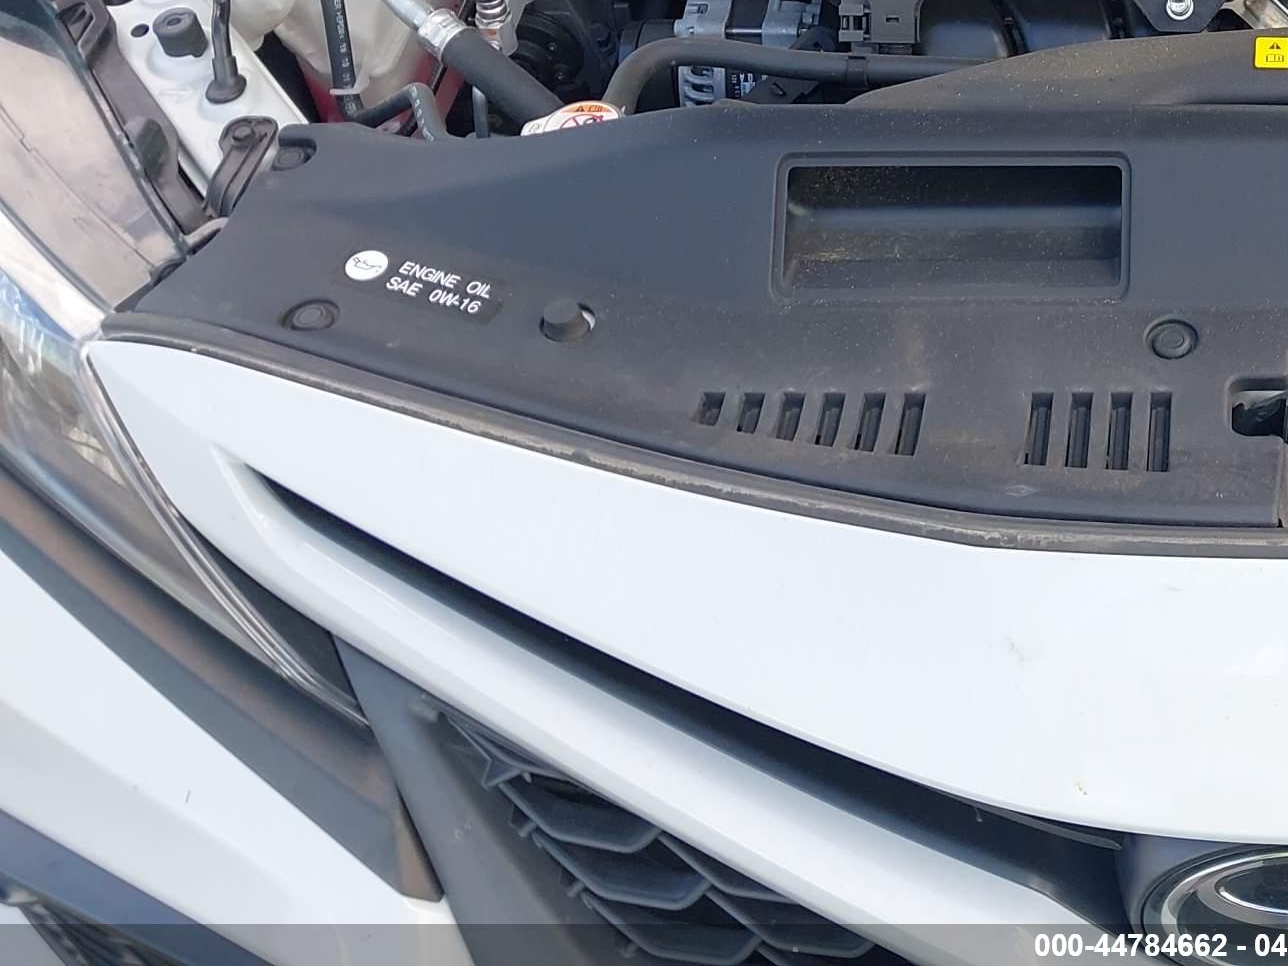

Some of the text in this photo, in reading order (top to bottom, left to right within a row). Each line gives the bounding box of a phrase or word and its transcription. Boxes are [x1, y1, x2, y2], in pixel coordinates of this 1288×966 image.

[386, 276, 481, 314] SAE 0W-16
[399, 261, 491, 298] ENGINE OIL
